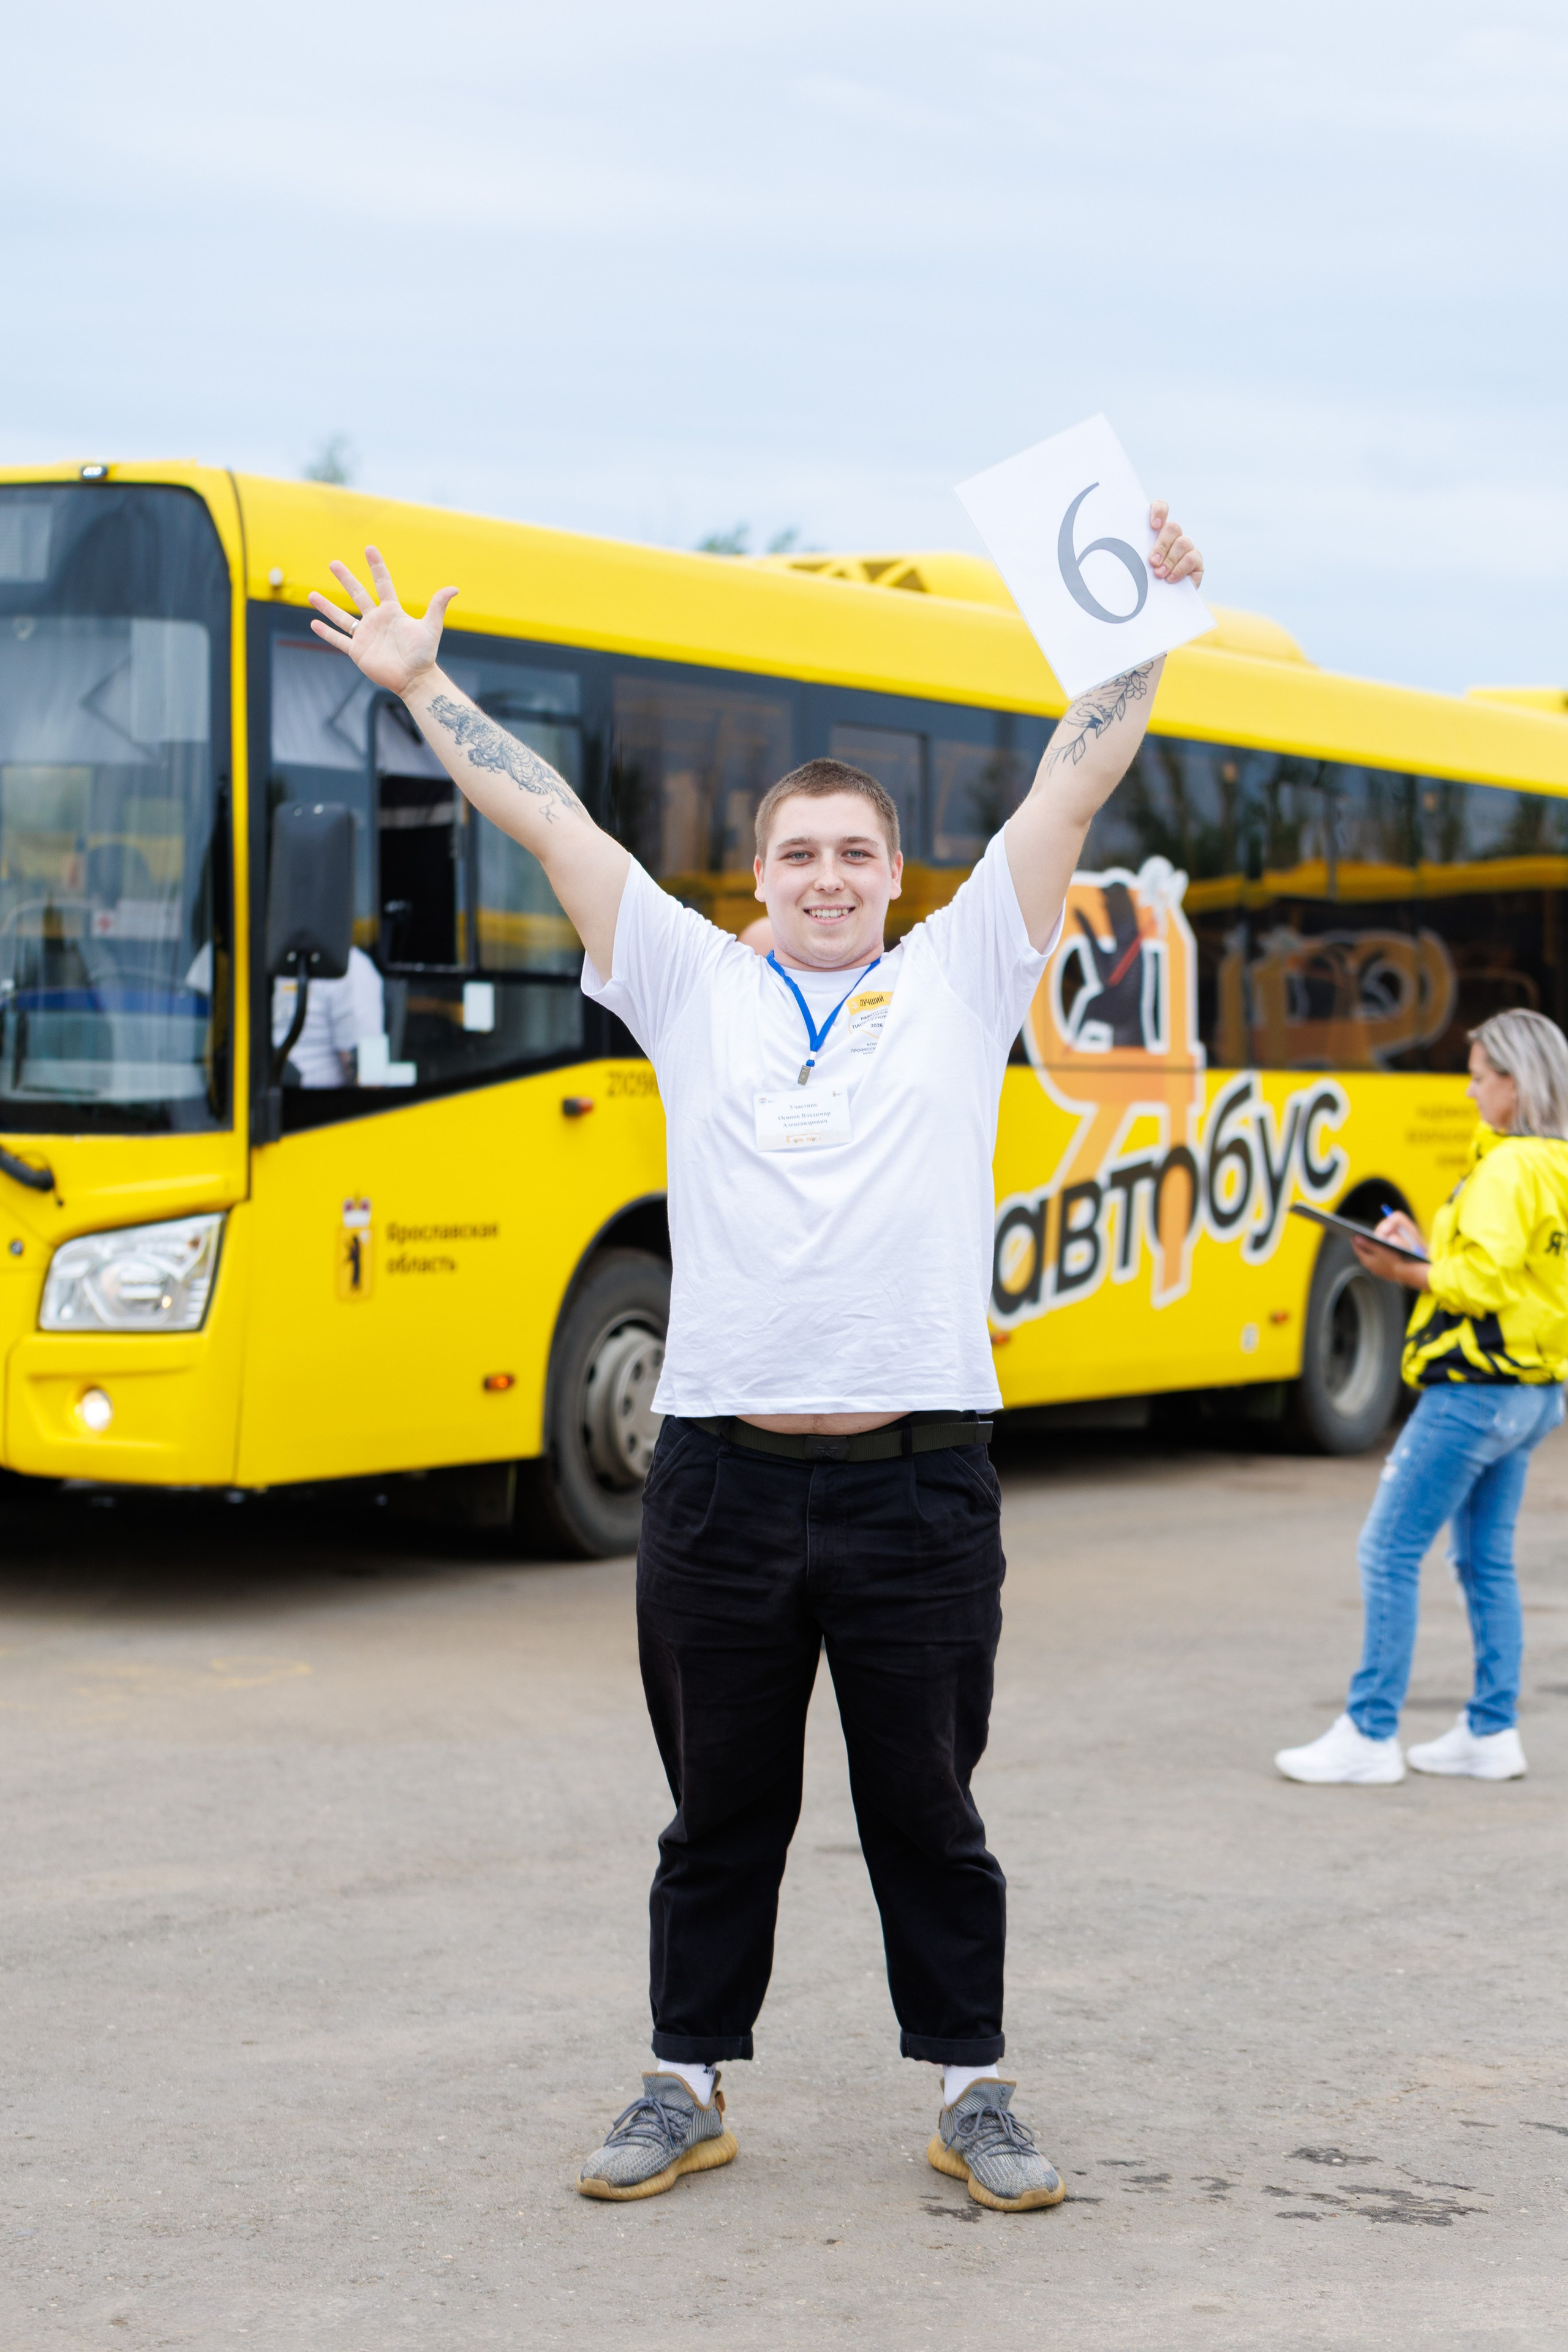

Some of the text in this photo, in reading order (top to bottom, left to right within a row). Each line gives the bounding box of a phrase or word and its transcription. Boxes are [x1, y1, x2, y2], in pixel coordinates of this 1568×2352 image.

[1057, 481, 1148, 624] 6
[859, 994, 884, 1007] ЛУЧШИЙ
[782, 1119, 828, 1128] Александрович
[990, 1081, 1341, 1317] автобус
[386, 1221, 499, 1245] Ярославская
[386, 1253, 456, 1275] область
